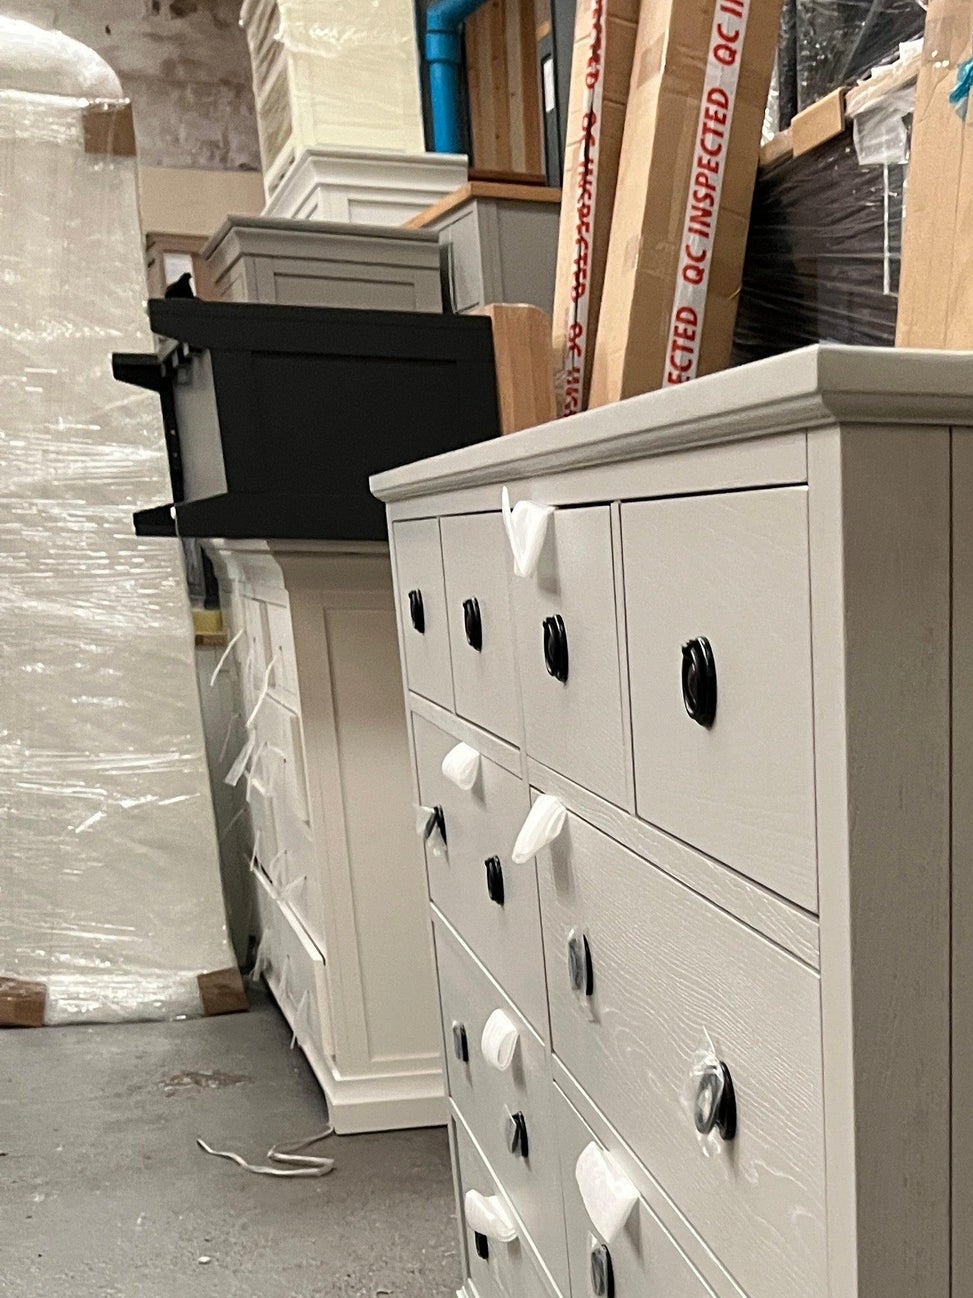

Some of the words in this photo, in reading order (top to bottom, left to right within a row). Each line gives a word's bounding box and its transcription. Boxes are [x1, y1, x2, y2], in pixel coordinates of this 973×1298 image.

[713, 22, 741, 67] QC
[688, 86, 730, 239] INSPECTED
[682, 243, 708, 286] QC
